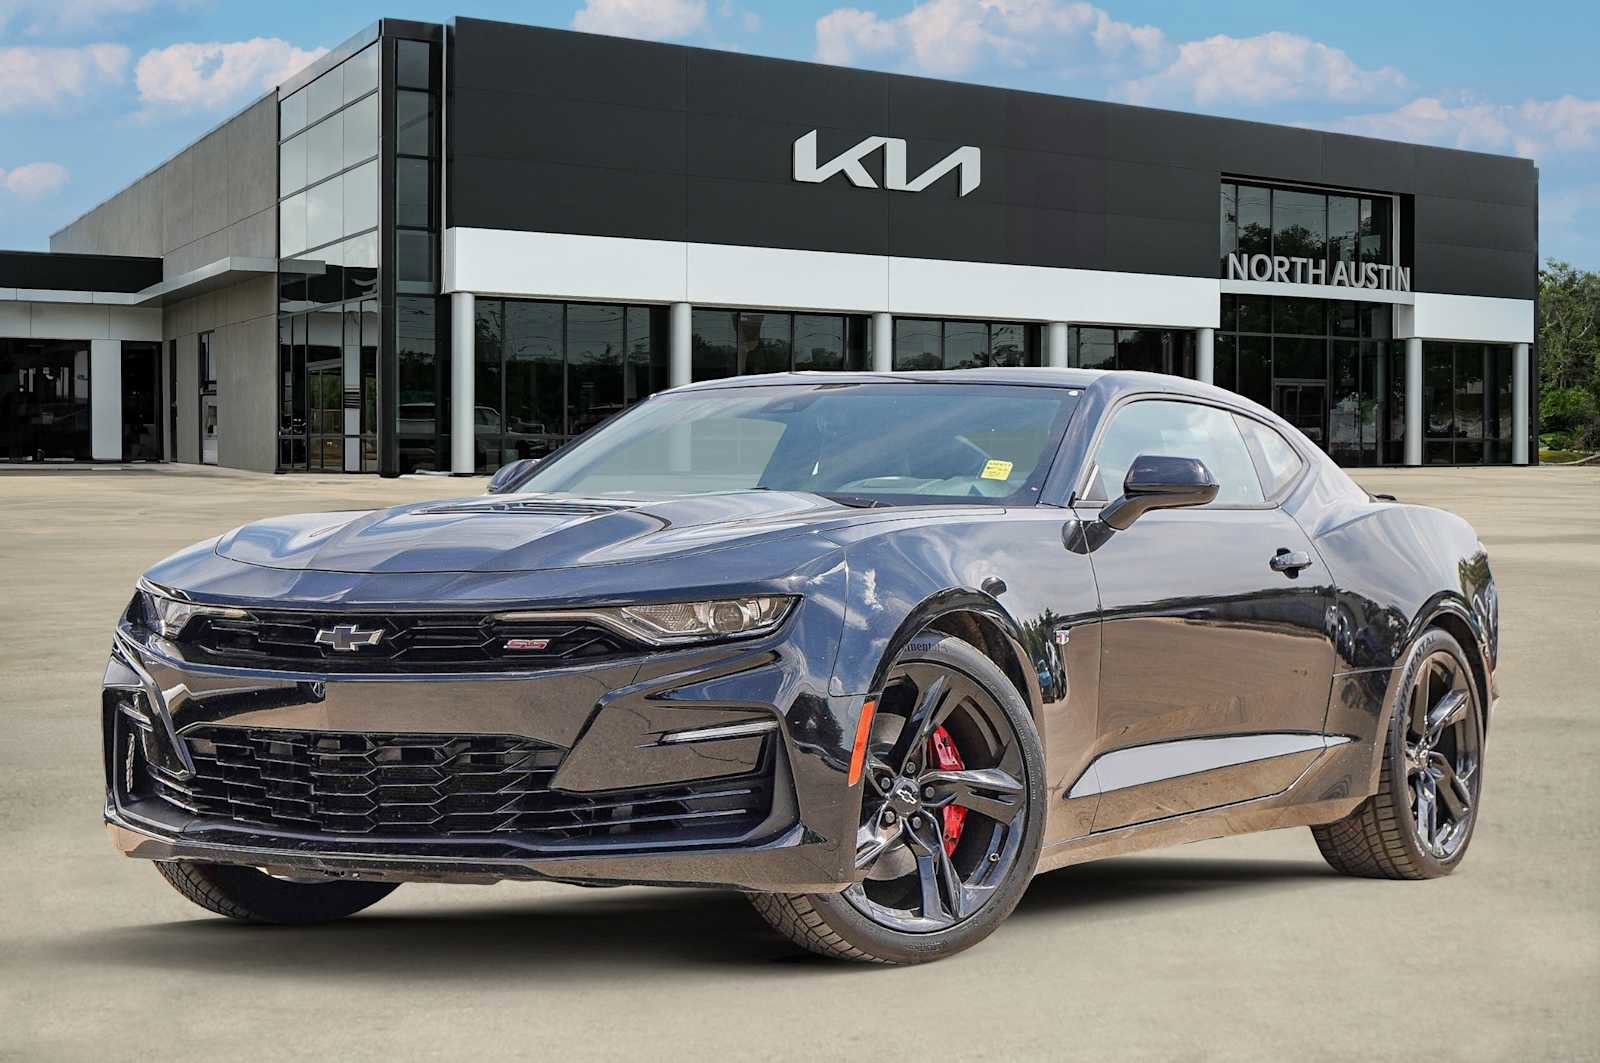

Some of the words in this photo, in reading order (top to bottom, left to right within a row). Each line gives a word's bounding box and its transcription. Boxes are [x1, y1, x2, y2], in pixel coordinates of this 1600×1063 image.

[793, 129, 981, 198] KIA
[1228, 253, 1326, 286] NORTH
[1330, 260, 1411, 292] AUSTIN
